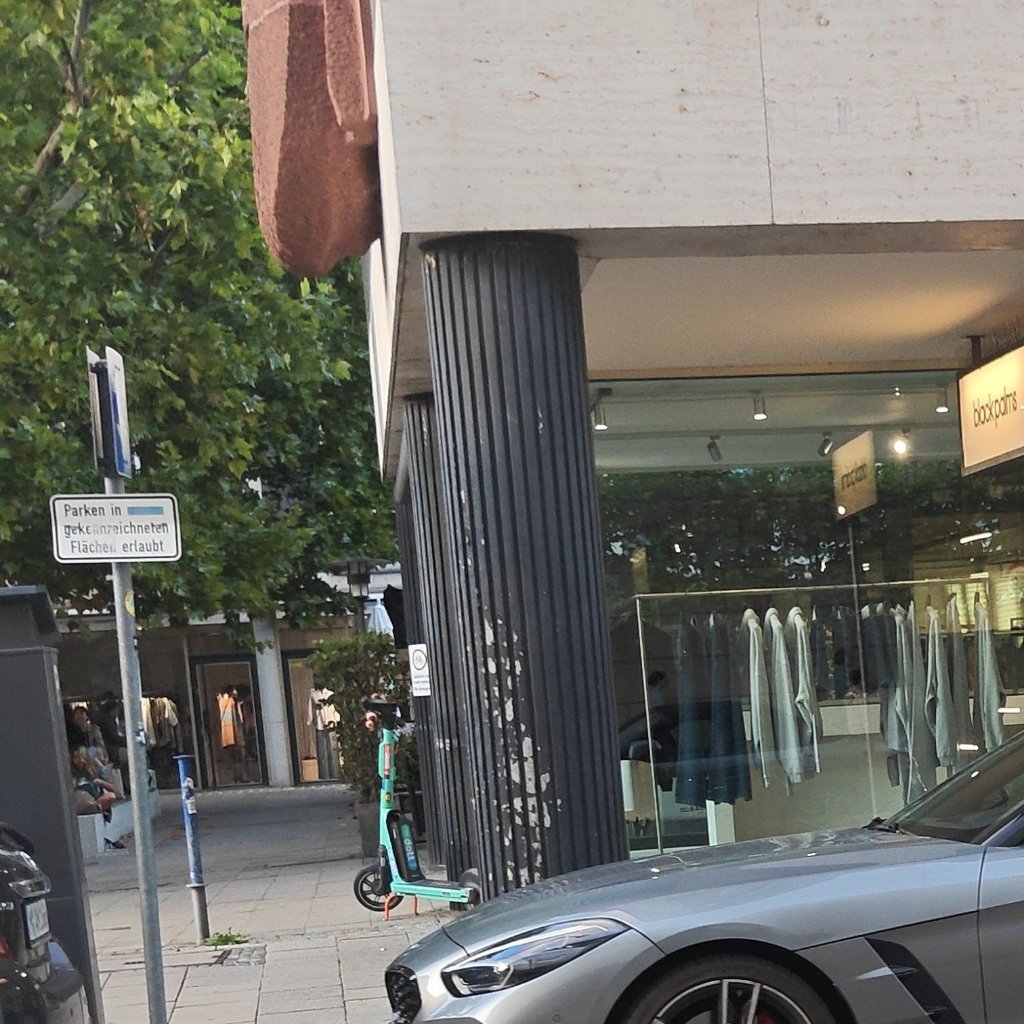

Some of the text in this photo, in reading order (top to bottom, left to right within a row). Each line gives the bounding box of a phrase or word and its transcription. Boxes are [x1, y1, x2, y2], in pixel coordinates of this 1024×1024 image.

[972, 386, 1018, 429] blackpalms
[64, 503, 122, 517] Parken in
[122, 539, 165, 553] erlaubt
[404, 838, 415, 862] dott
